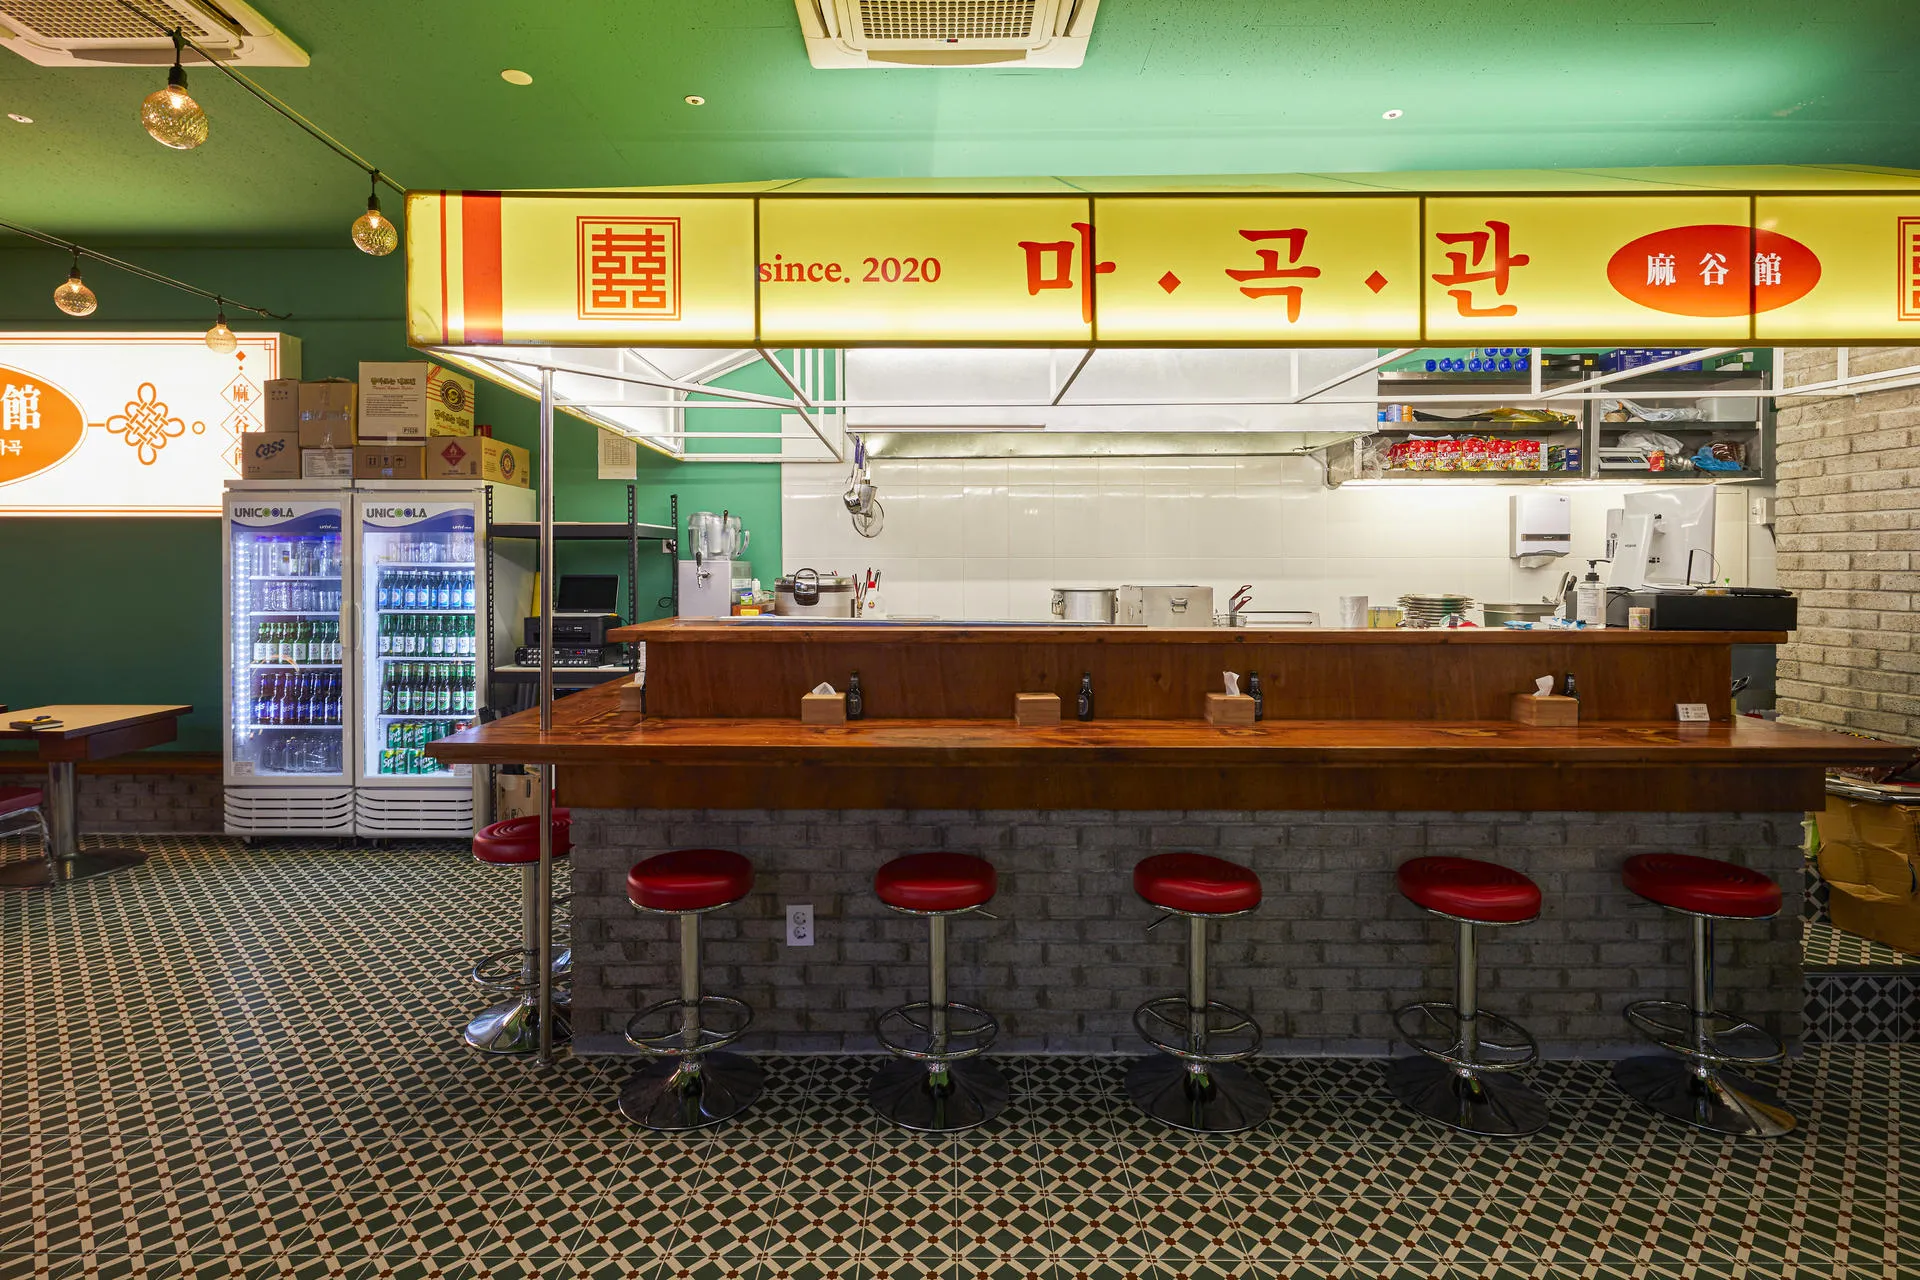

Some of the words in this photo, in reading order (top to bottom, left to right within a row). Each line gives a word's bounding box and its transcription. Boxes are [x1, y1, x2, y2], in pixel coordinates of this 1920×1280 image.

[758, 254, 851, 283] since.
[862, 257, 942, 283] 2020
[255, 439, 285, 458] Cass
